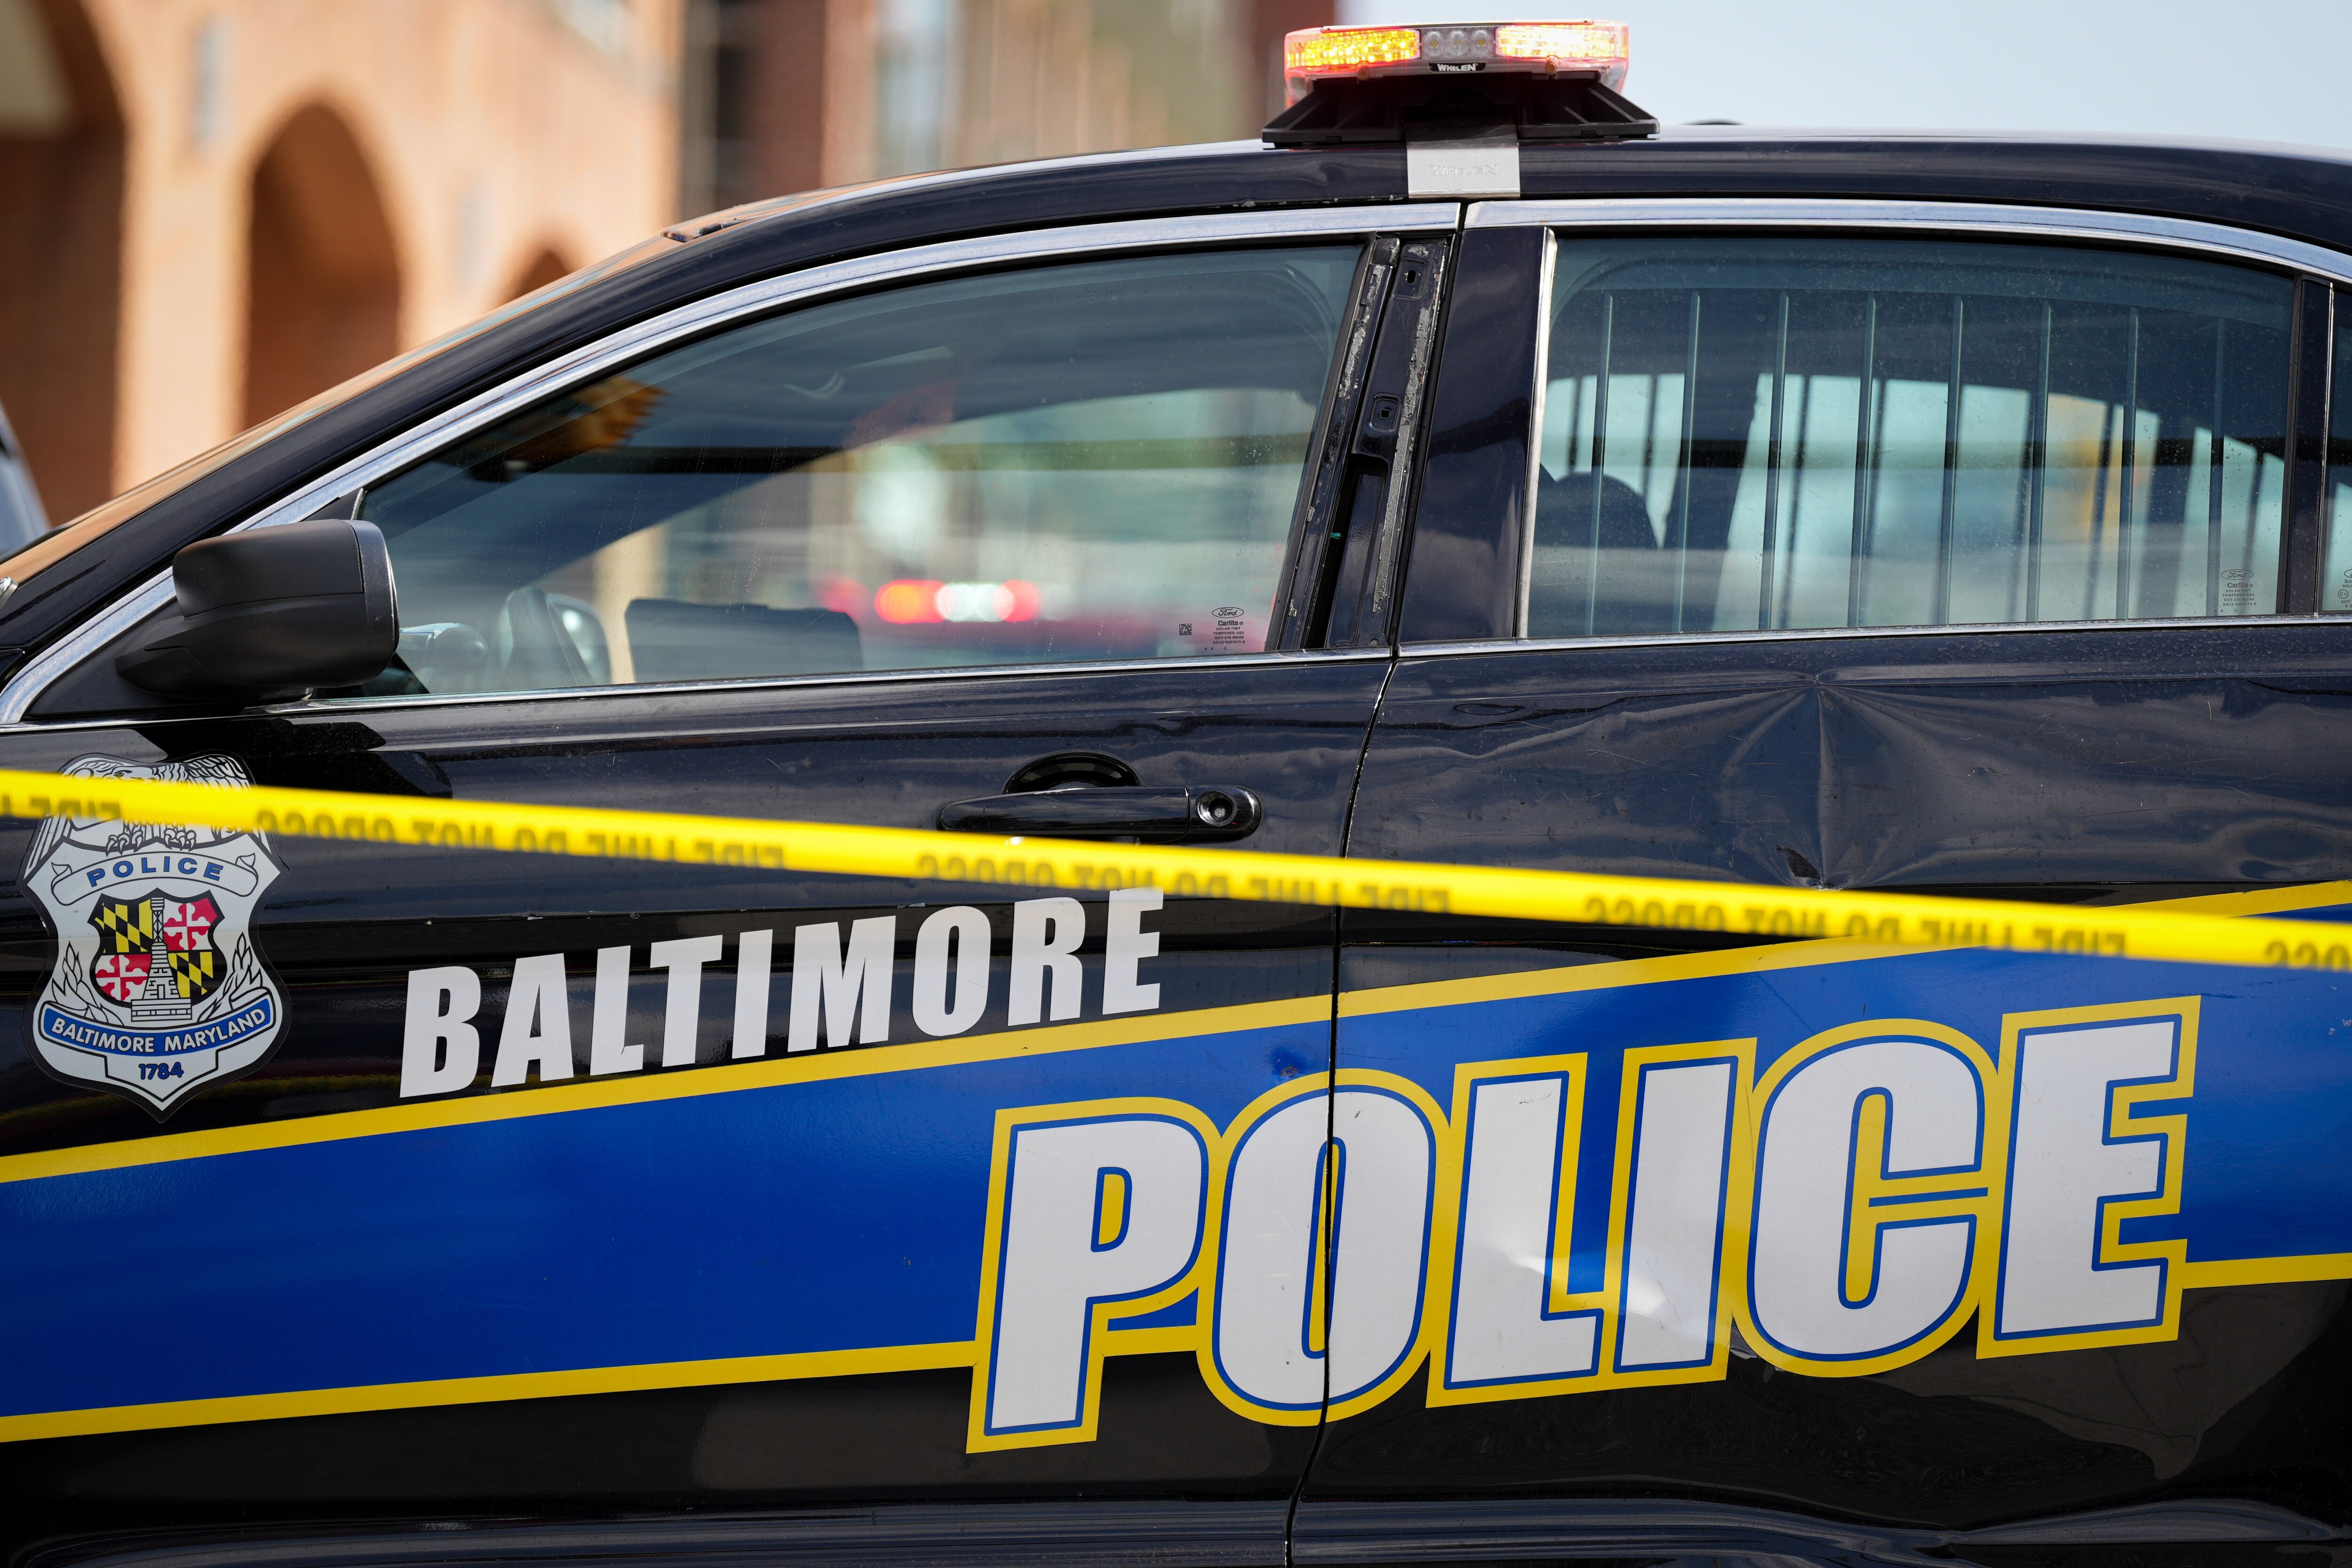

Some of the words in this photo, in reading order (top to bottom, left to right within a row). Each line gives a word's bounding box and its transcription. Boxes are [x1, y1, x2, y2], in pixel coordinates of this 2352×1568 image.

[87, 856, 224, 887] POLICE
[399, 887, 1164, 1099] BALTIMORE
[52, 1017, 154, 1053] BALTIMORE
[164, 1008, 266, 1052] MARYLAND
[139, 1062, 184, 1080] 1784
[968, 994, 2201, 1455] POLICE
